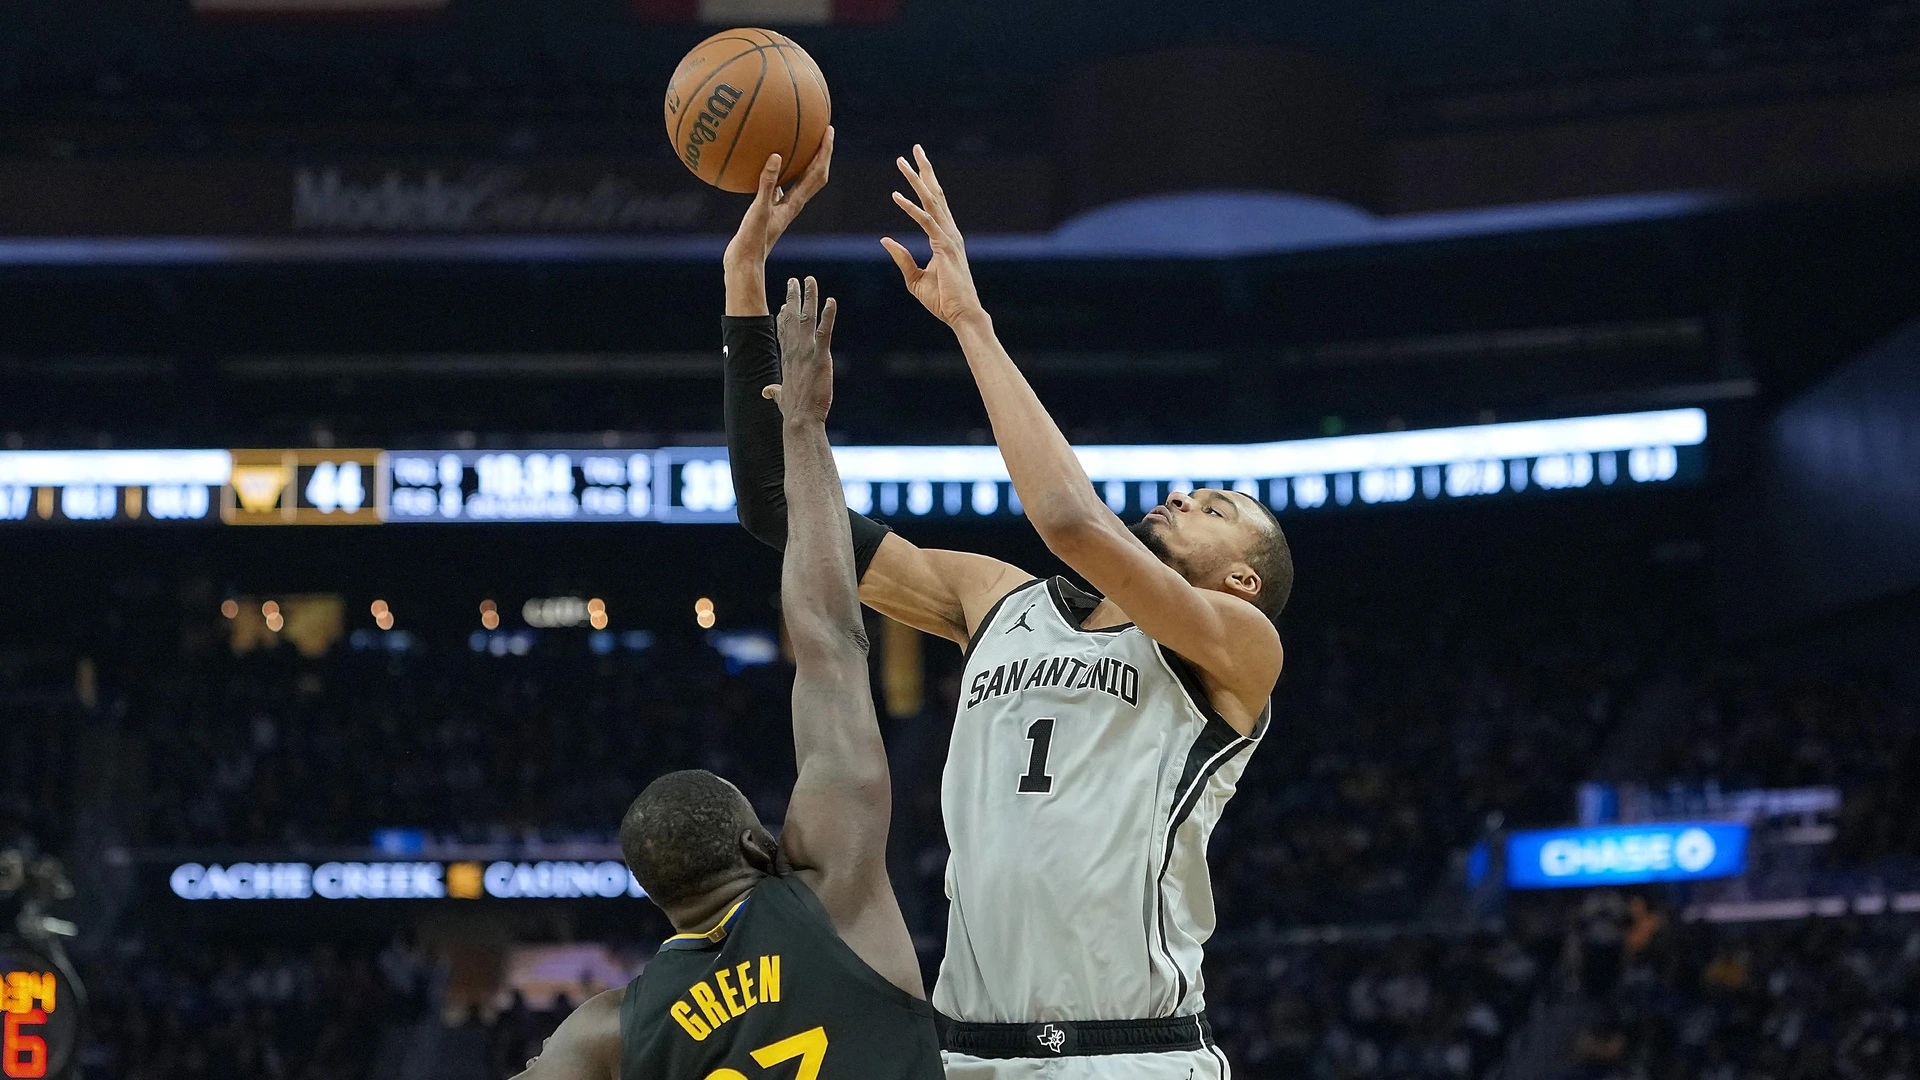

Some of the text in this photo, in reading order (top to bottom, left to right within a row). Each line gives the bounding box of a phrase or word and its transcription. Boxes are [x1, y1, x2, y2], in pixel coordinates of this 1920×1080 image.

[685, 81, 745, 171] Wilson
[967, 657, 1029, 711] SAN
[1016, 717, 1057, 795] 1
[484, 861, 629, 898] CASINO
[670, 955, 782, 1041] GREEN
[3, 1008, 48, 1078] 6
